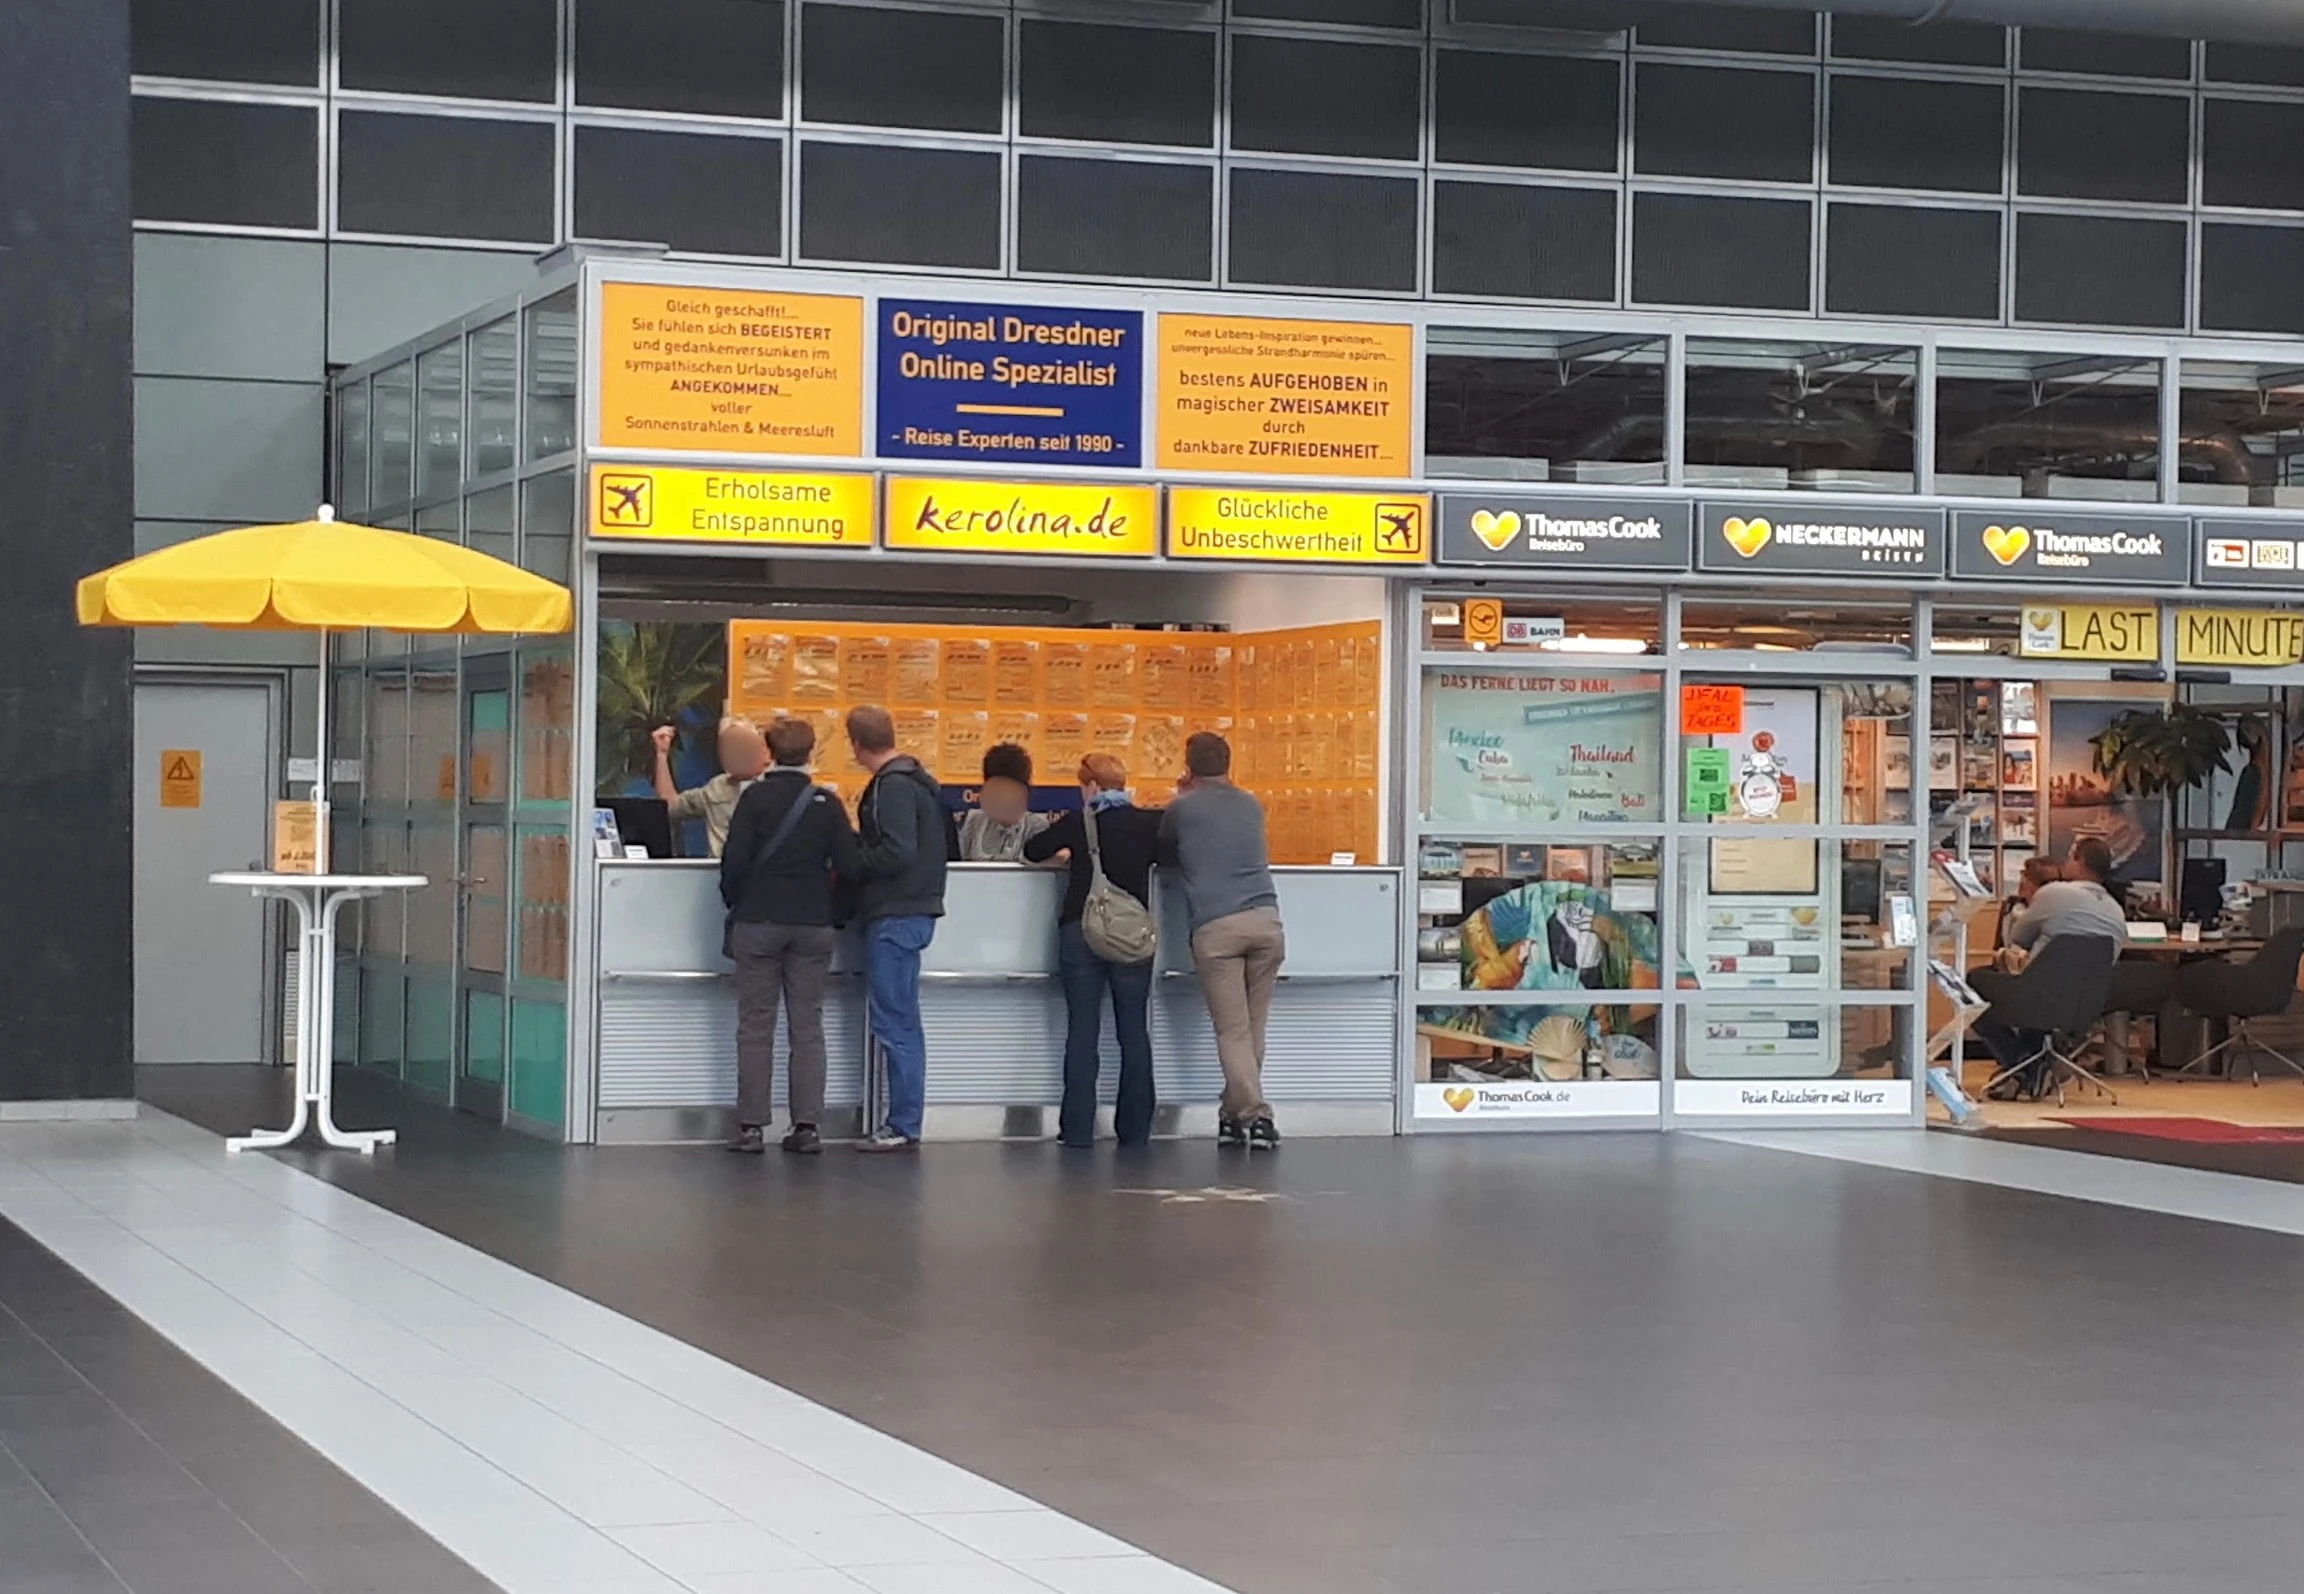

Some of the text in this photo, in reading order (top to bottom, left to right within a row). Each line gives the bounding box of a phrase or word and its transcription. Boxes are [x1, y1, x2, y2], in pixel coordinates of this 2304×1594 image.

[632, 317, 655, 331] Sie
[708, 321, 737, 336] sich
[740, 323, 832, 341] BEGEISTERT
[892, 311, 1126, 348] Original Dresdner
[633, 338, 831, 361] und gedankenversunken im
[624, 358, 733, 375] sympathischen
[900, 351, 1118, 389] Online Spezialist
[1179, 370, 1388, 393] bestens AUFGEHOBEN in
[711, 401, 753, 414] voller
[1176, 395, 1390, 417] magischer ZWEISAMKEIT
[625, 415, 836, 439] Sonnenstrahlen & Meeresluft
[1262, 420, 1305, 434] durch
[904, 427, 953, 447] Reise
[957, 429, 1036, 452] Experten
[1039, 433, 1071, 450] seit
[1075, 434, 1113, 453] 1990
[1173, 439, 1244, 456] dankbare
[705, 477, 832, 503] Erholsame
[914, 495, 1130, 539] kerolina.de
[1216, 496, 1329, 521] Glückliche
[691, 508, 845, 540] Entspannung
[1774, 523, 1926, 549] NECKERMANN
[1180, 525, 1363, 553] Unbeschwertheit
[2061, 610, 2304, 659] LAST MINUTE
[1441, 673, 1467, 689] DAS
[1470, 675, 1514, 690] FERNE
[1518, 677, 1555, 692] LIEGT
[1559, 678, 1577, 692] SO
[1569, 743, 1635, 764] Thailand
[1854, 1089, 1885, 1104] Herz
